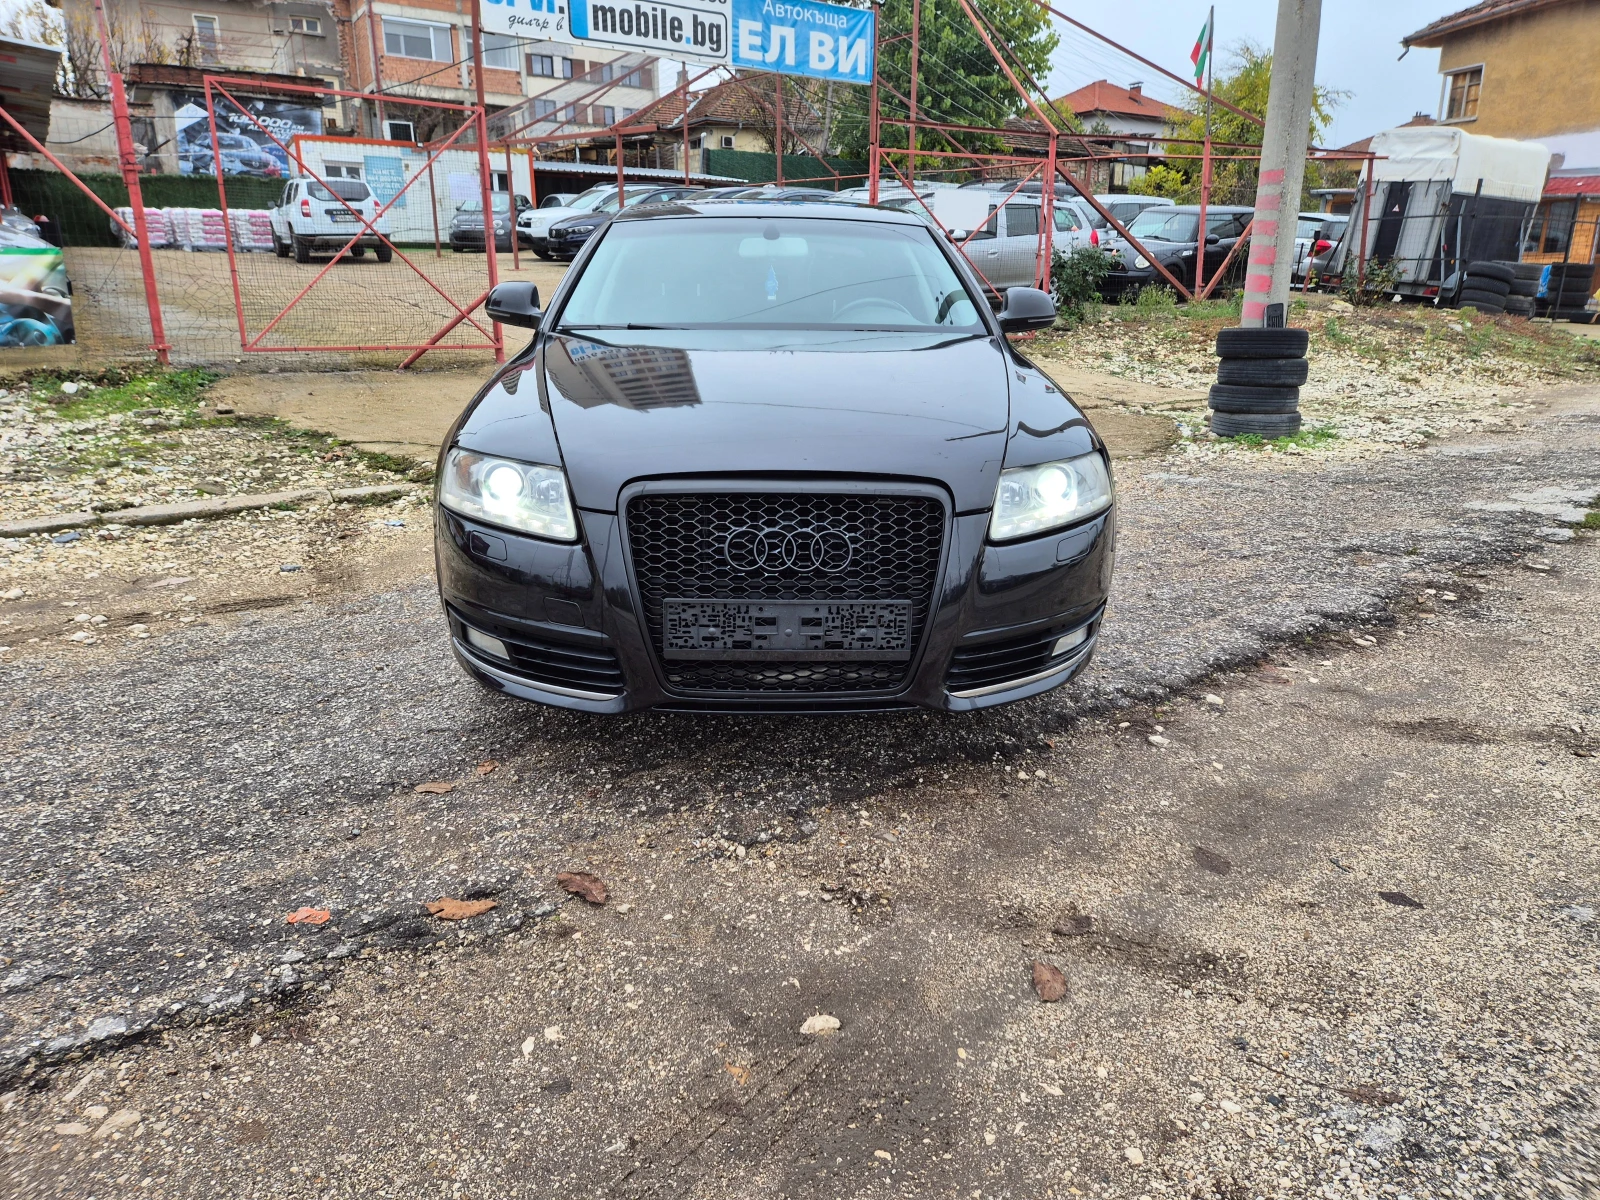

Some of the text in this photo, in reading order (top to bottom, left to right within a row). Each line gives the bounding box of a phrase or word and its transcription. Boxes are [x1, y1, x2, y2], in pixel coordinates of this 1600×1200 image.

[508, 14, 565, 32] дилър в
[592, 3, 722, 52] mobile.bg
[762, 0, 848, 29] Автокъща
[738, 19, 867, 75] ЕЛ ВИ
